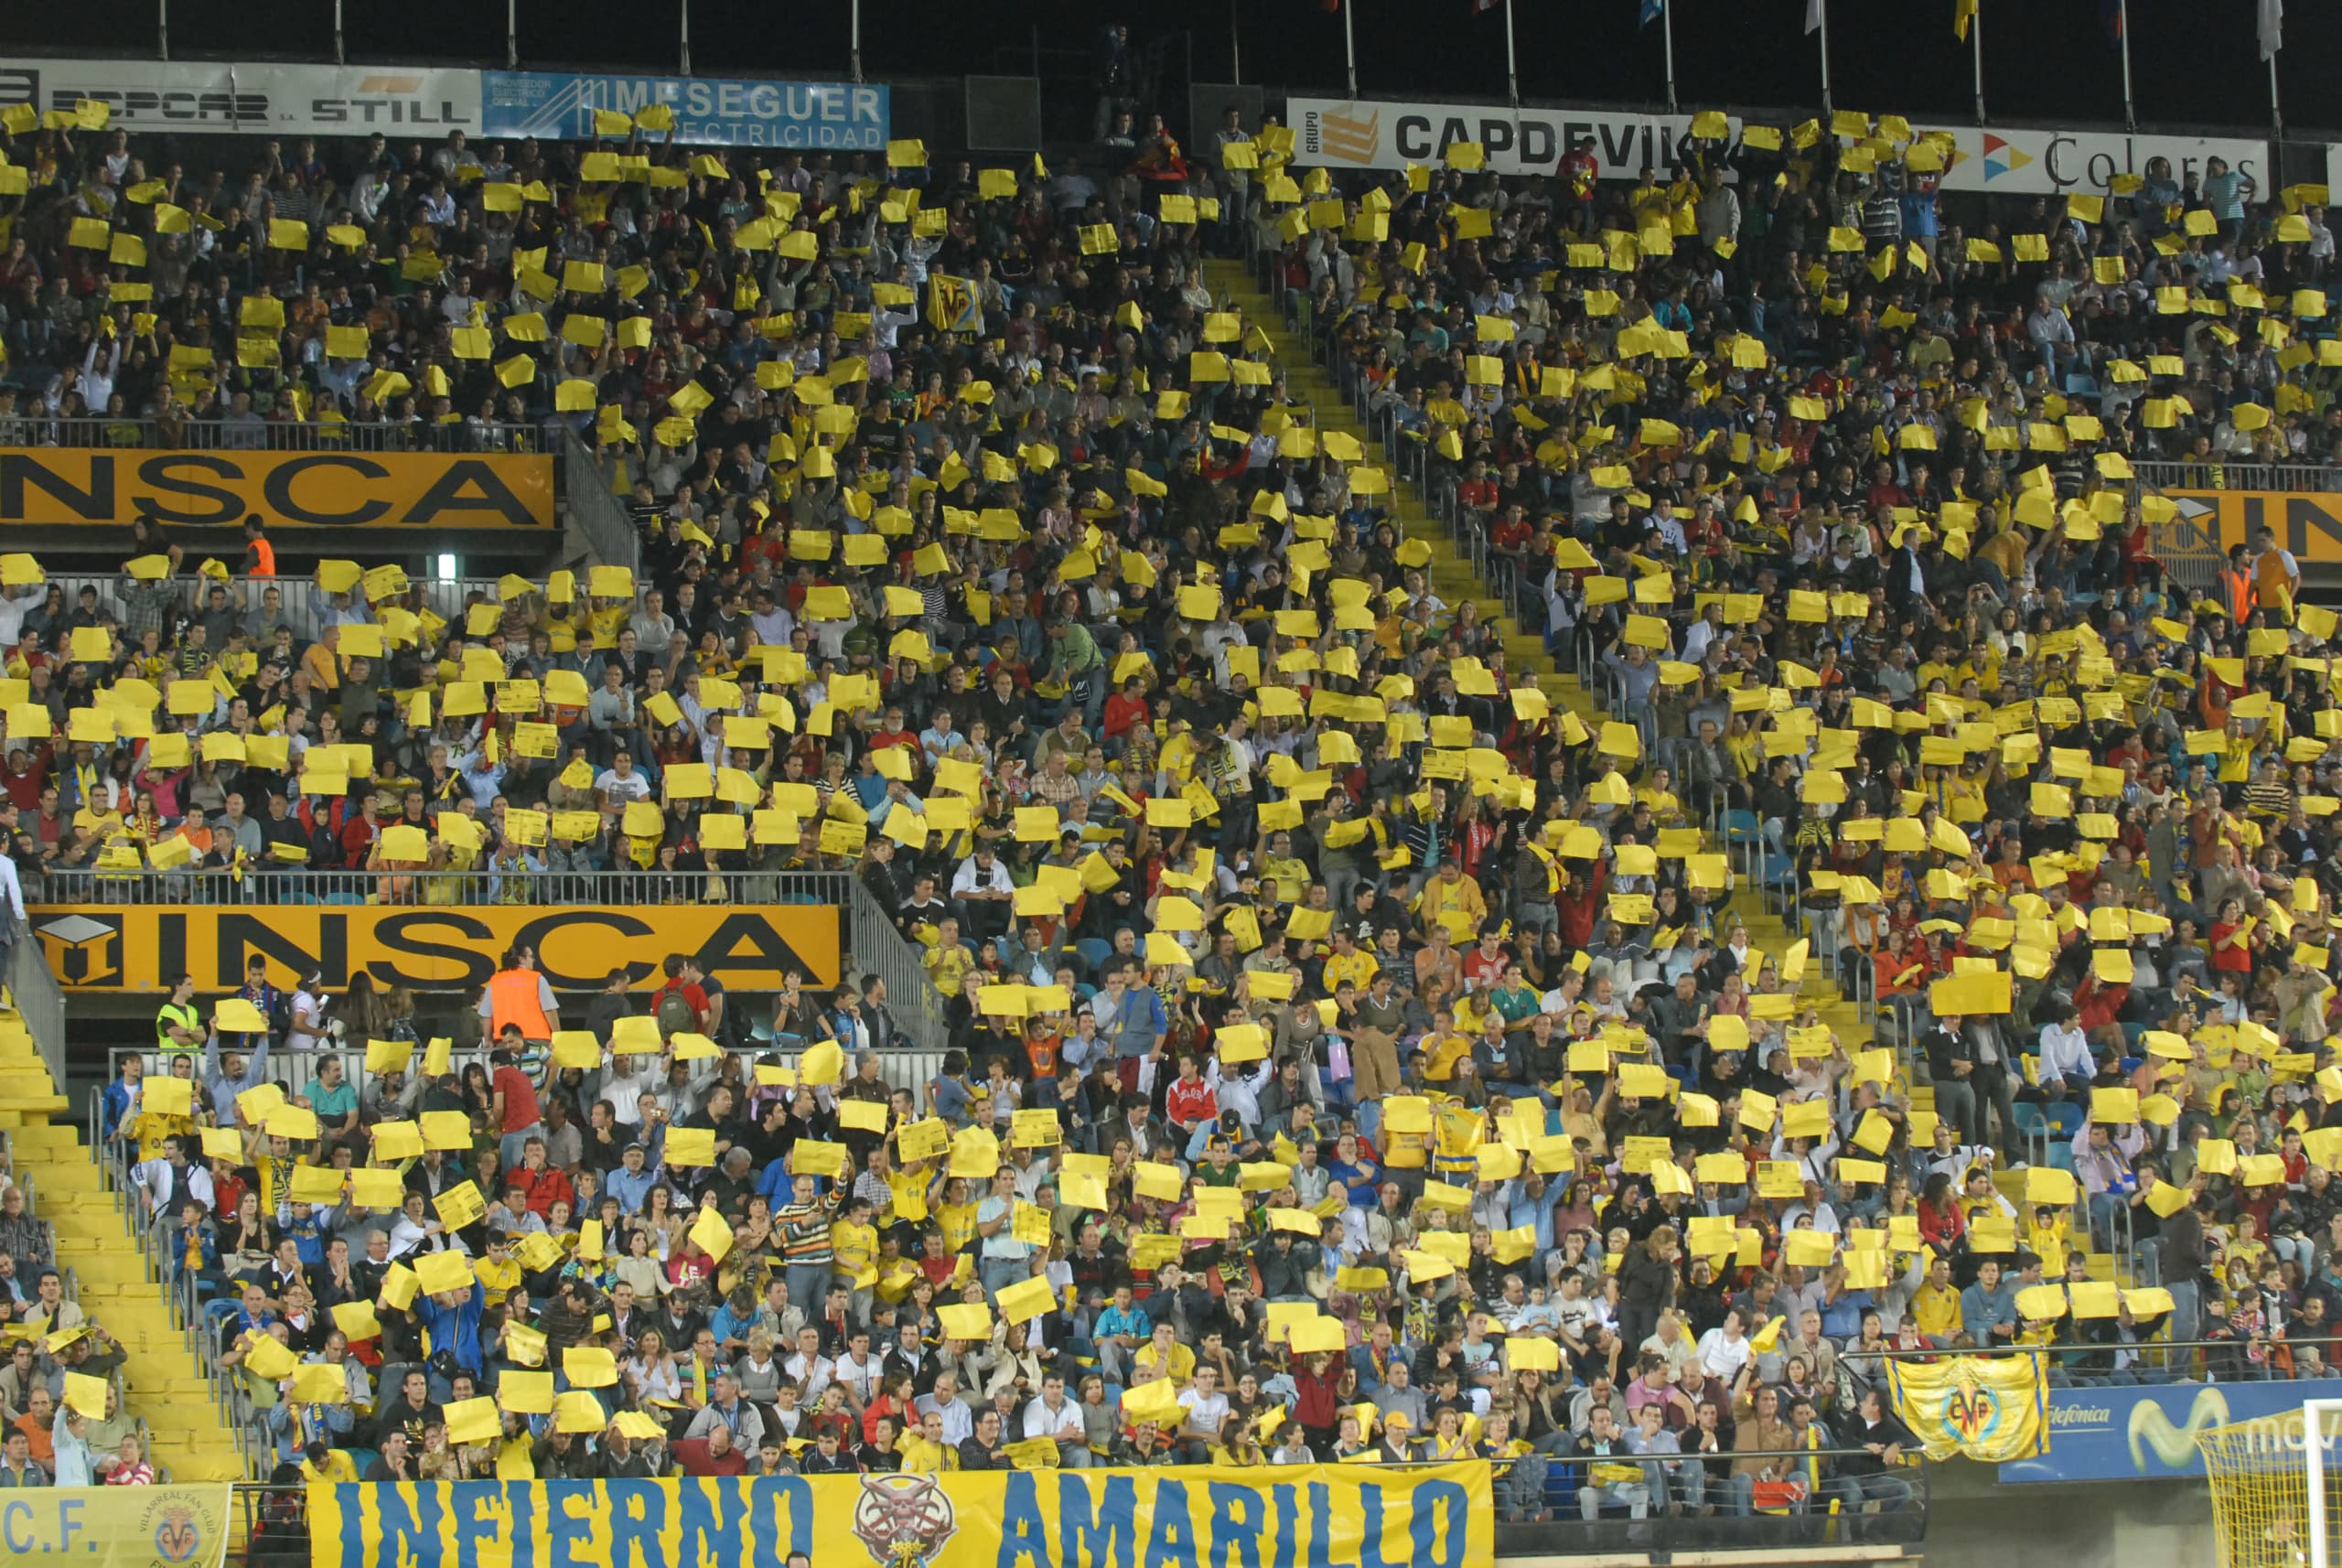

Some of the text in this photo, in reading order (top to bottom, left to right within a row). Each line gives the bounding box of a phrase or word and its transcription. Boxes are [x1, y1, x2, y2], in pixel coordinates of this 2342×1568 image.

[312, 99, 471, 124] STILL
[615, 80, 881, 123] MESEGUER
[1305, 111, 1318, 154] GRUPO
[1395, 115, 1728, 172] CAPDEVIL
[158, 910, 825, 992] INSCA
[3, 1498, 97, 1554] C.F.
[139, 1490, 182, 1533] VILLARREAL
[184, 1492, 204, 1509] FAN
[332, 1476, 818, 1568] INFIERNO
[995, 1469, 1471, 1568] AMARILLO
